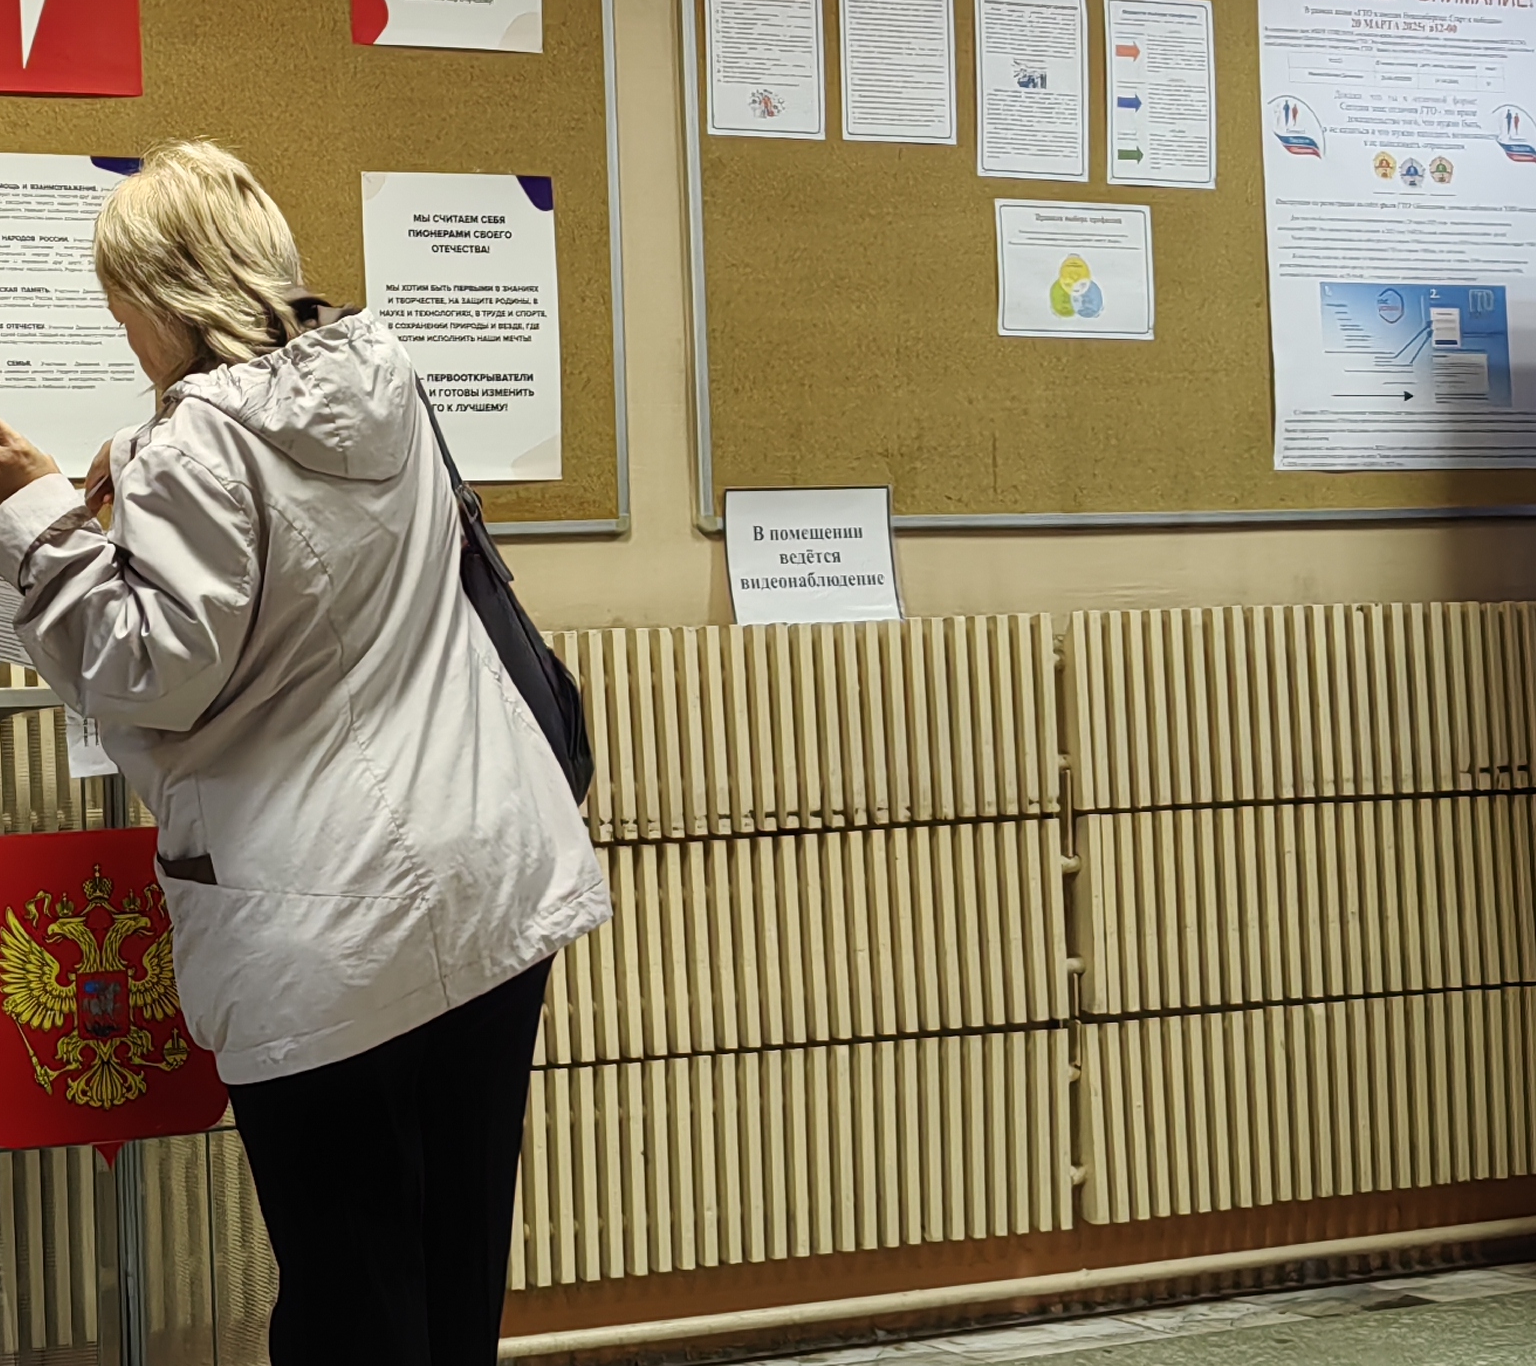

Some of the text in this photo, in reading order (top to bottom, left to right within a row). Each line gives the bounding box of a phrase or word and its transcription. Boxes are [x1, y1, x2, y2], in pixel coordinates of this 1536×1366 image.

[1351, 18, 1361, 28] 20
[1364, 20, 1399, 30] МАРТА
[414, 215, 505, 224] МЫ СЧИТАЕМ СЕБЯ
[408, 230, 512, 239] ПИОНЕРАМИ СВОЕГО
[432, 245, 489, 253] ОТЕЧЕСТВА!
[427, 374, 533, 382] ПЕРВООТКРЫВАТЕЛИ
[429, 389, 534, 397] И ГОТОВЫ ИЗМЕНИТЬ
[447, 404, 453, 412] К
[455, 404, 508, 412] ЛУЧШЕМУ!
[753, 526, 862, 541] В помещении
[780, 550, 841, 564] ведётся
[741, 573, 884, 590] видеонаблюдение
